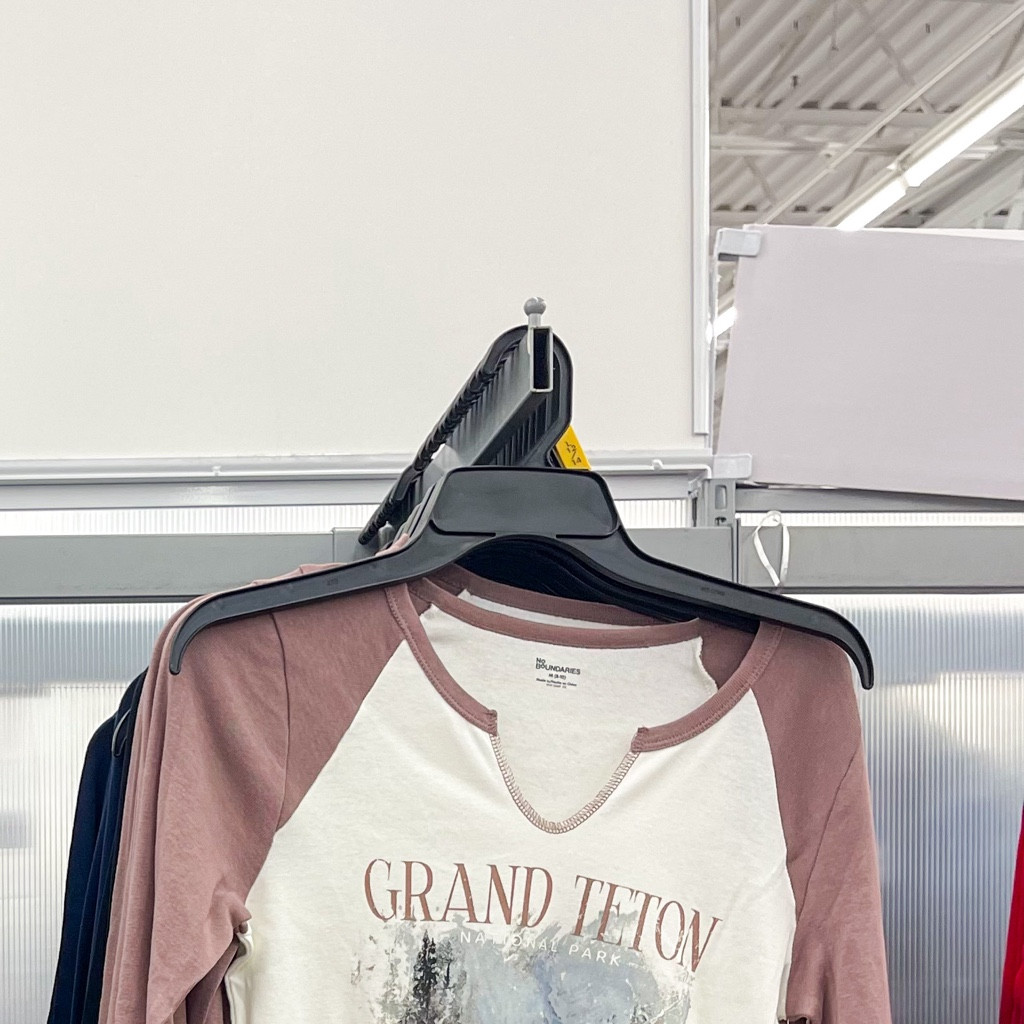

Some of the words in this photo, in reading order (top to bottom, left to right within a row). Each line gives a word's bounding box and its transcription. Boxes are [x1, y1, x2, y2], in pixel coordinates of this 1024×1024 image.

[363, 858, 554, 929] GRAND
[570, 874, 724, 973] TETON
[568, 944, 622, 967] PARK
